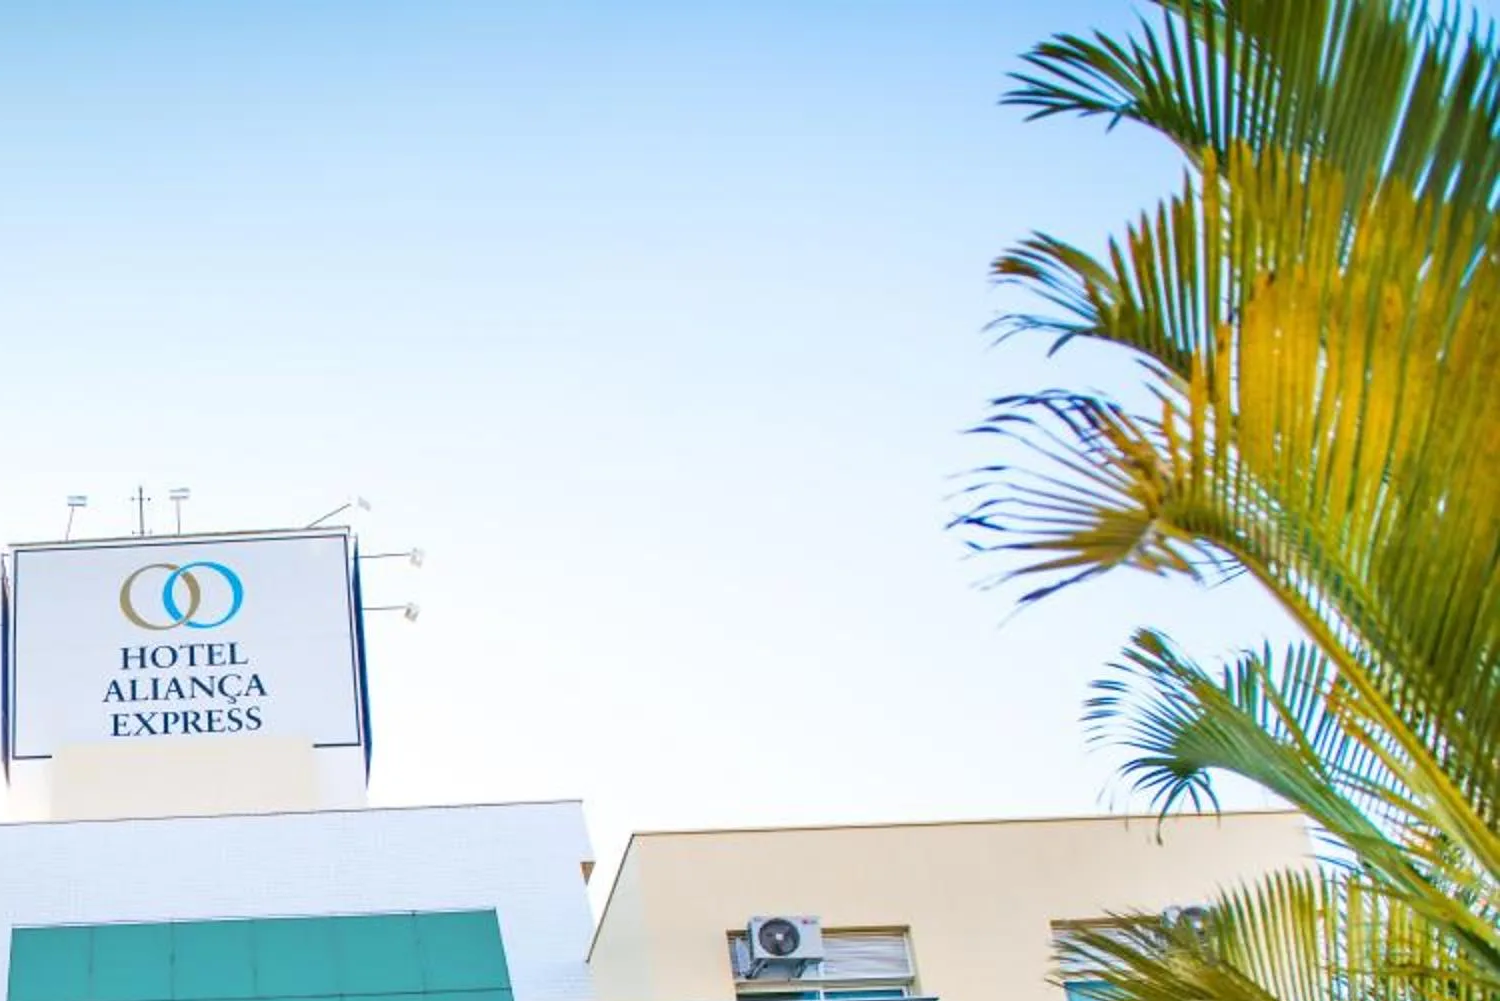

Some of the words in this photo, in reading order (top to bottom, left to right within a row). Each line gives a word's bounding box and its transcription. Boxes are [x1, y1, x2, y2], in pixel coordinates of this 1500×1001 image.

[120, 641, 249, 670] HOTEL
[102, 673, 268, 705] ALIANÇA
[110, 706, 263, 737] EXPRESS
